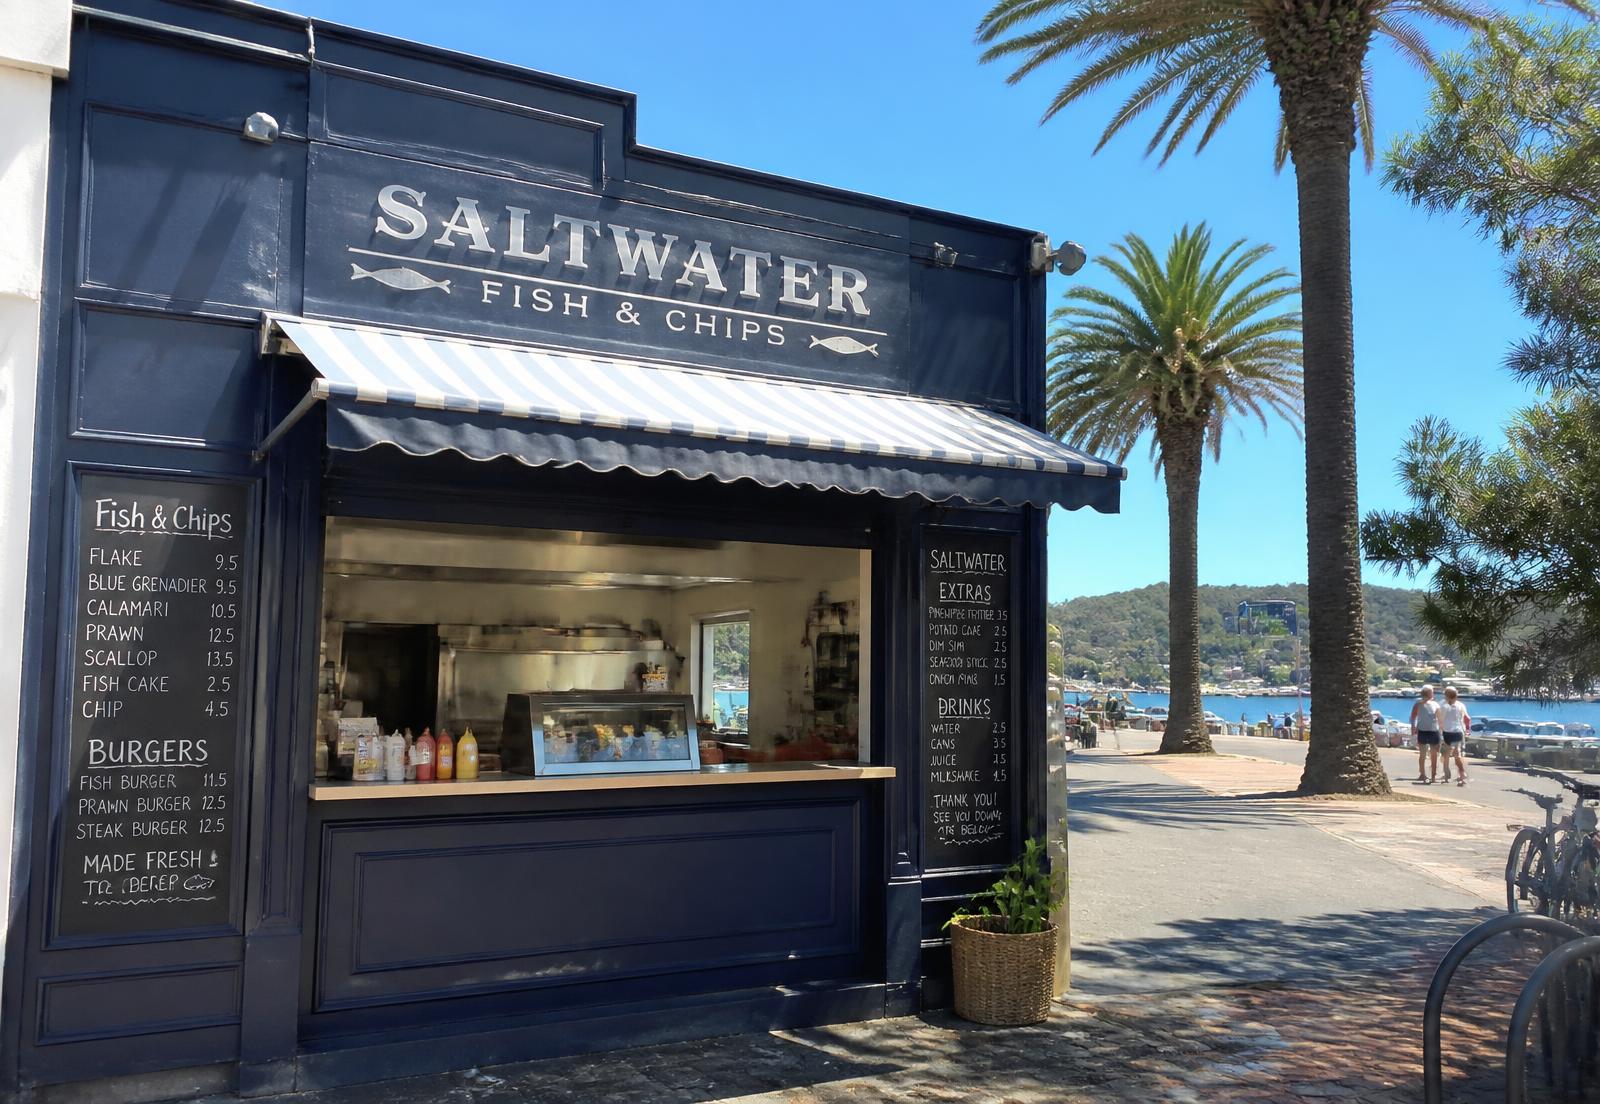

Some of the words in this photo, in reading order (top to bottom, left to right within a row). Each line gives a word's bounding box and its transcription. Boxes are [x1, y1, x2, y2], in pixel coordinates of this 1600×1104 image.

[374, 184, 871, 316] SALTWATER
[481, 280, 588, 318] FISH
[615, 301, 641, 326] &
[666, 310, 785, 346] CHIPS
[96, 498, 144, 528] Fish
[152, 504, 167, 529] &
[173, 506, 232, 540] Chips
[90, 548, 142, 566] FLAKE
[216, 554, 238, 570] 9.5
[931, 549, 1006, 572] SALTWATER
[88, 573, 126, 591] BLUE
[133, 576, 207, 594] GRENADIER
[216, 579, 237, 594] 9.5
[940, 582, 991, 601] EXTRAS
[87, 599, 168, 616] CALAMARI
[211, 604, 236, 618] 10.5
[86, 624, 144, 641] PRAWN
[209, 628, 234, 643] 12.5
[929, 623, 958, 635] POTATO
[929, 640, 944, 652] DIM
[84, 650, 157, 666] SCALLOP
[207, 651, 233, 667] 13.5
[83, 675, 119, 692] FISH
[128, 676, 169, 692] CAKE
[207, 676, 231, 692] 2.5
[994, 674, 1006, 686] 1.5
[82, 700, 122, 718] CHIP
[205, 701, 228, 717] 4.5
[939, 698, 990, 715] DRINKS
[931, 723, 960, 734] WATER
[993, 722, 1006, 734] 2.5
[88, 739, 208, 764] BURGERS
[931, 738, 955, 749] CANS
[930, 754, 956, 766] JUICE
[80, 776, 112, 790] FISH
[121, 774, 176, 790] BURGER
[203, 773, 227, 787] 11.5
[79, 799, 128, 816] PRAWN
[137, 796, 191, 812] BURGER
[202, 796, 226, 810] 12.5
[934, 794, 968, 808] THANK
[974, 792, 997, 806] YOU!
[934, 811, 950, 823] SEE
[77, 823, 123, 839] STEAK
[132, 820, 188, 837] BURGER
[200, 818, 225, 833] 12.5
[84, 854, 136, 874] MADE
[147, 849, 201, 870] FRESH
